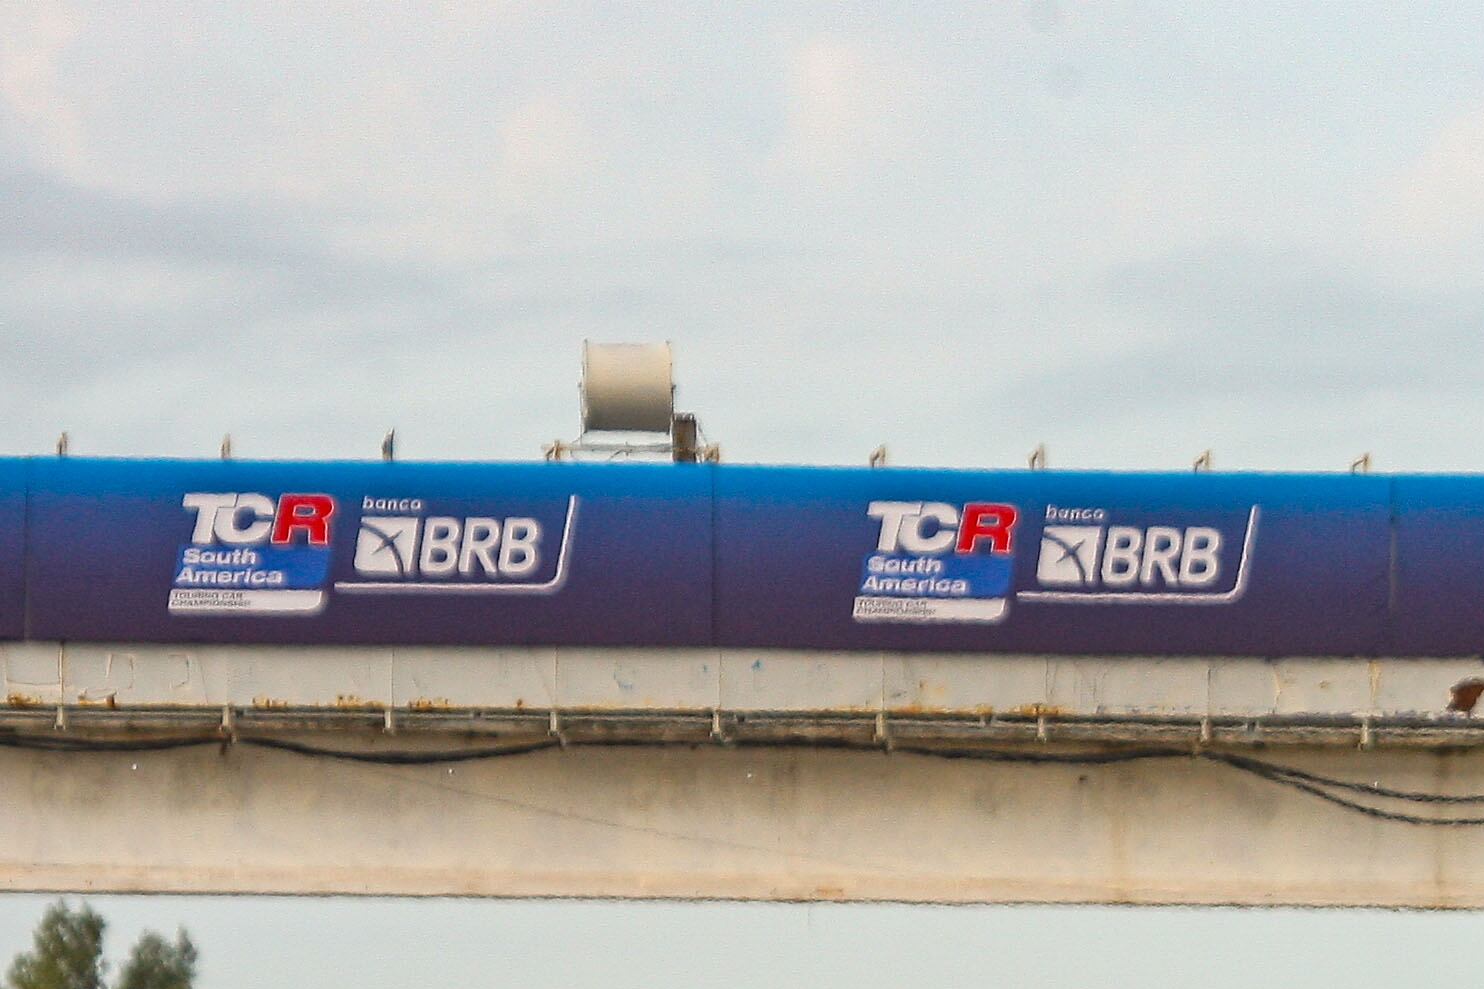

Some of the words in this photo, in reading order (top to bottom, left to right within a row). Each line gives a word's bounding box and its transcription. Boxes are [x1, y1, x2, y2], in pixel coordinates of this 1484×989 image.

[363, 496, 422, 511] banco
[1046, 504, 1105, 520] banco
[183, 493, 335, 545] TCR
[868, 501, 1018, 554] TCR
[420, 517, 539, 577] BRB
[183, 549, 256, 565] South
[868, 556, 941, 573] South
[1102, 526, 1221, 587] BRB
[176, 568, 282, 585] America
[863, 577, 967, 594] America
